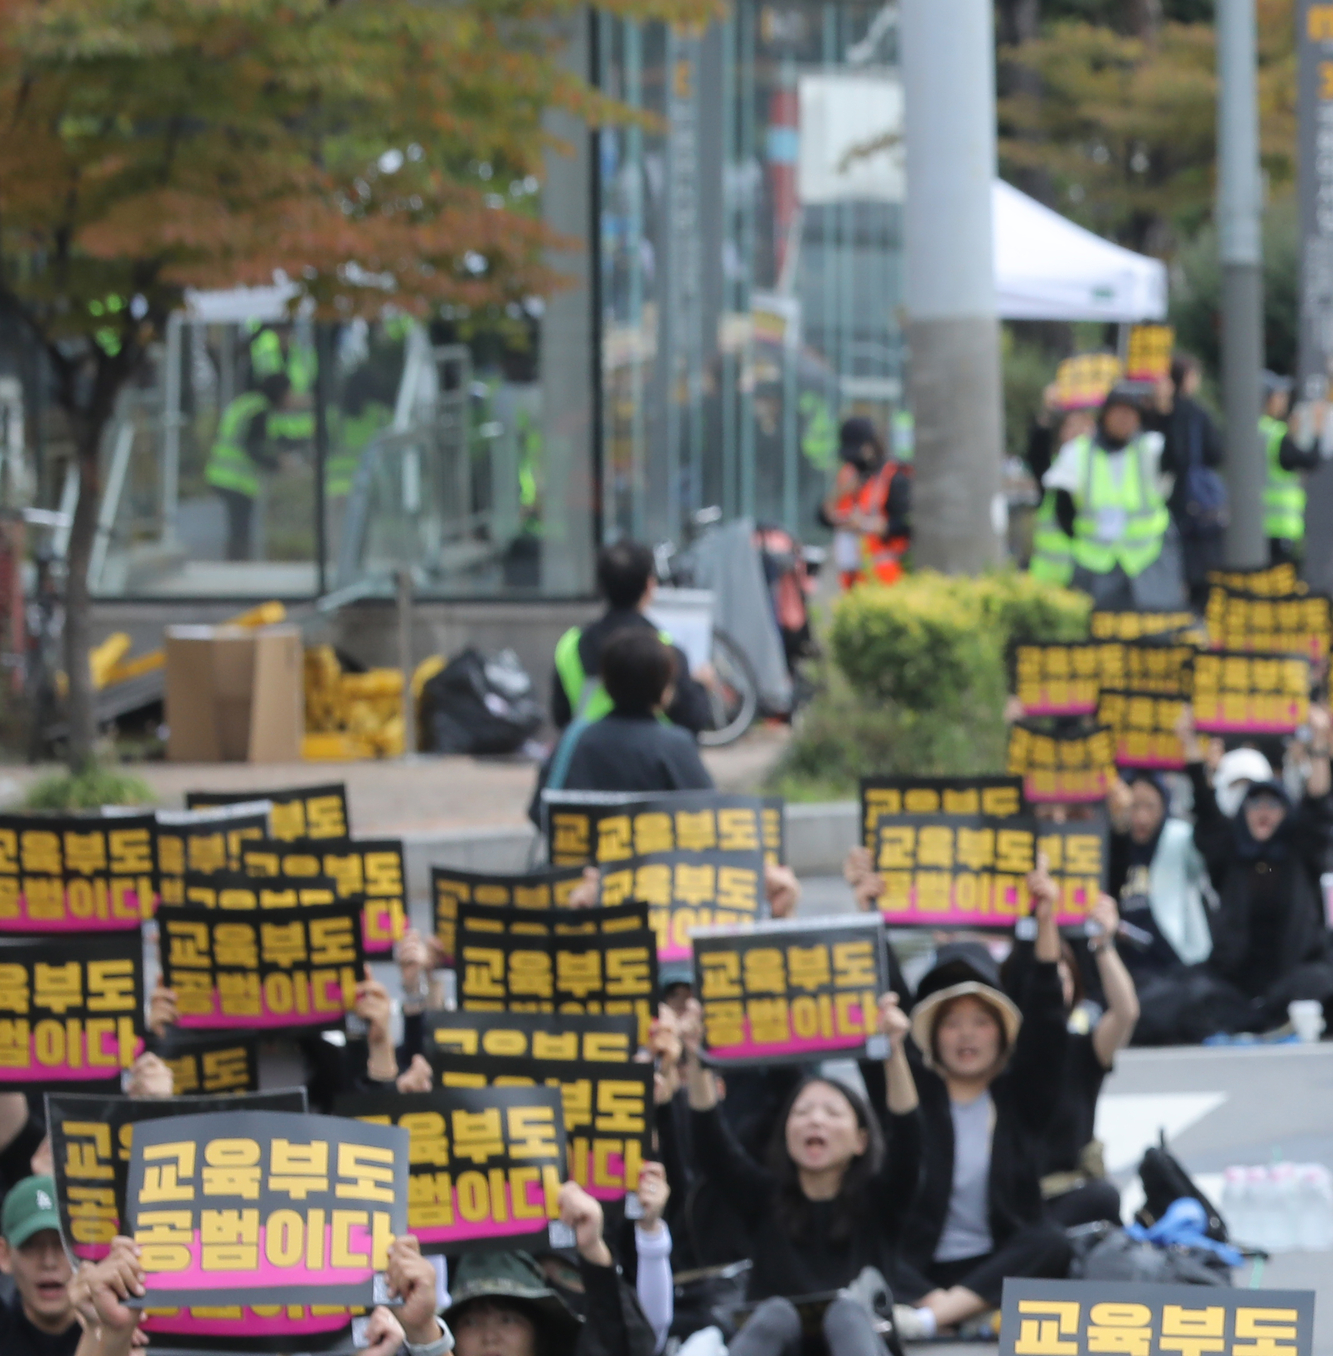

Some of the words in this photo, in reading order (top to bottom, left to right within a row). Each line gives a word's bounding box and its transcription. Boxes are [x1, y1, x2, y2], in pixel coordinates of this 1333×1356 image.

[166, 917, 357, 968] 교육부도
[700, 941, 877, 997] 교육부도
[168, 965, 359, 1017] 공범이다
[463, 947, 651, 997] 교육부도
[702, 992, 880, 1046] 공범이다
[139, 1138, 395, 1202] 교육부도
[139, 1208, 396, 1272] 공범이다
